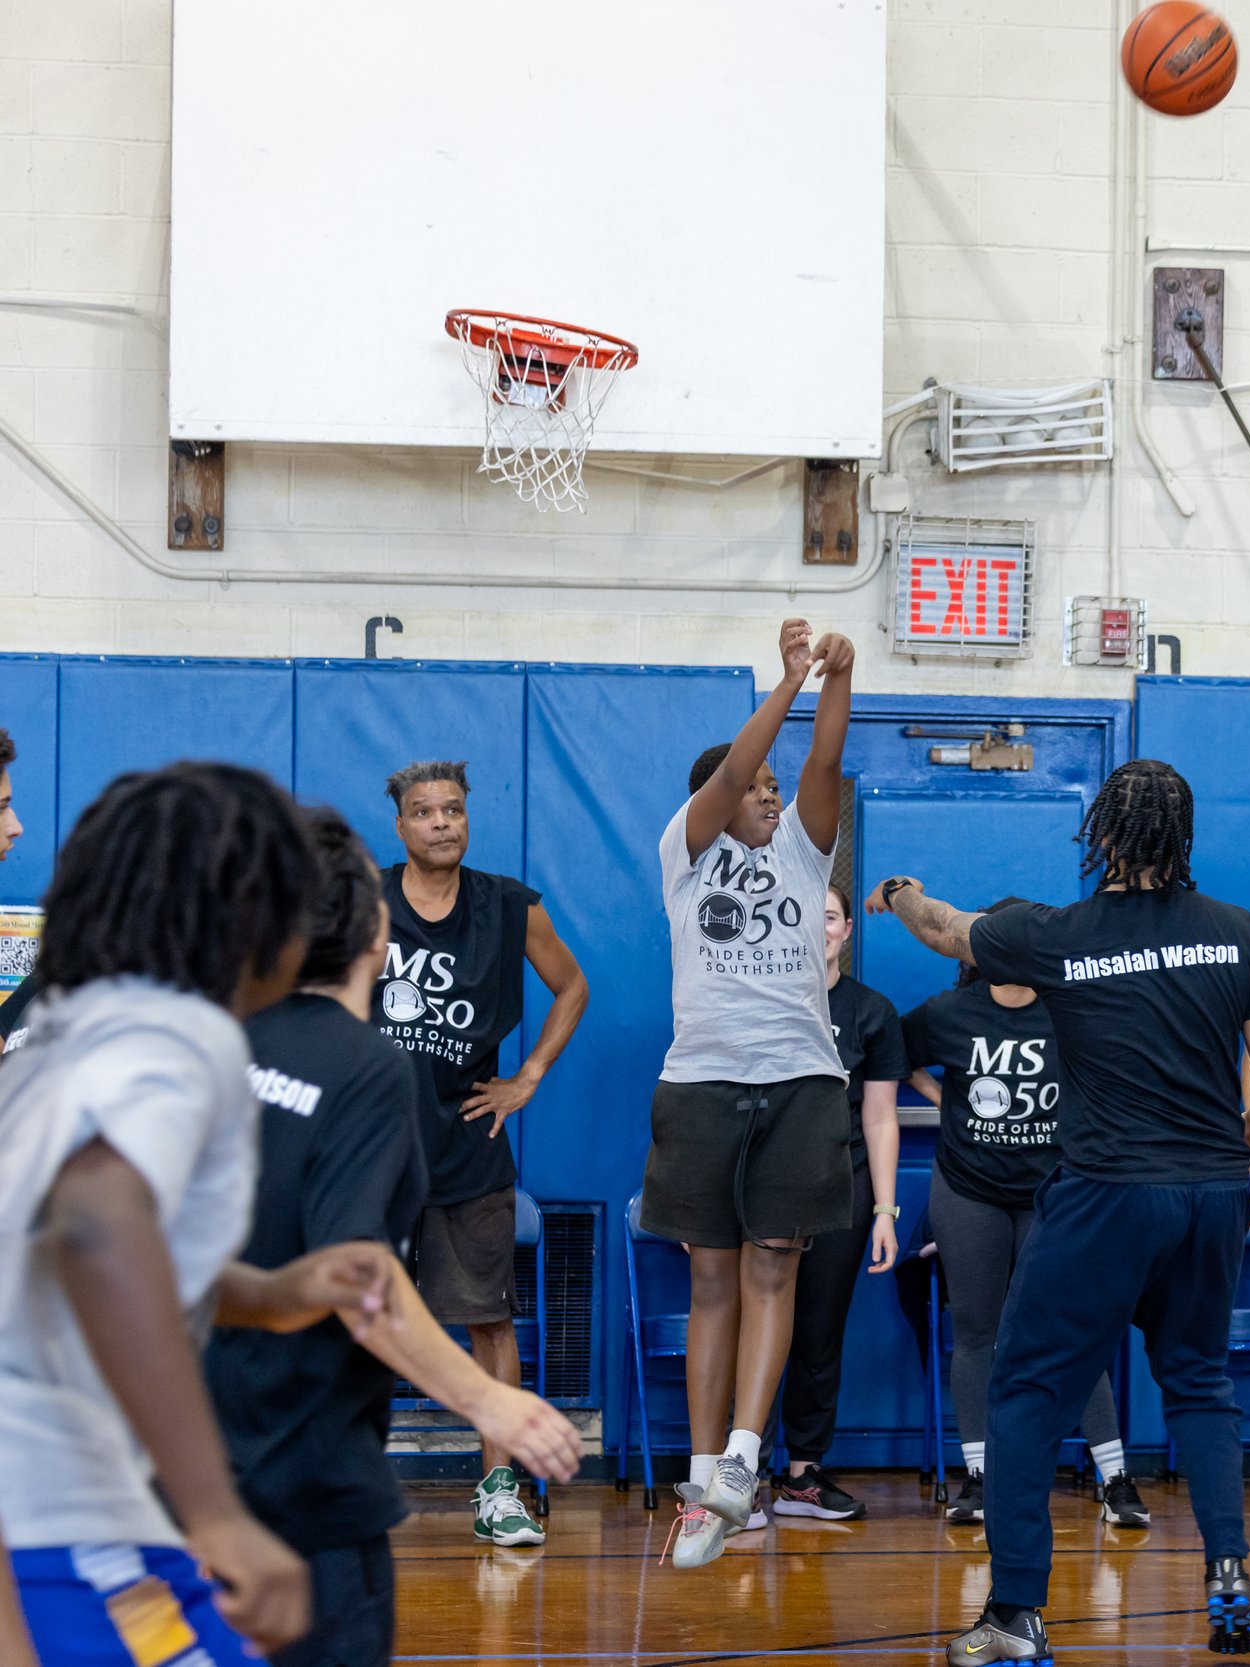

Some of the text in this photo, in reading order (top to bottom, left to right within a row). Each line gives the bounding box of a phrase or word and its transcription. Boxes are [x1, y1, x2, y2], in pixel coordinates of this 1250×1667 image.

[910, 558, 1017, 636] EXIT
[704, 848, 776, 894] MS
[746, 896, 802, 944] 50
[377, 942, 456, 991] MS
[699, 945, 808, 961] PRIDE OF THE
[706, 961, 803, 975] SOUTHSIDE
[1064, 943, 1239, 981] Jahsaiah Watson
[425, 996, 475, 1030] 50
[447, 1039, 472, 1053] THE
[966, 1037, 1046, 1076] MS
[1007, 1082, 1060, 1120] 50
[967, 1119, 1006, 1134] PRIDE
[1011, 1124, 1030, 1134] OF
[974, 1132, 1052, 1145] SOUTHSIDE
